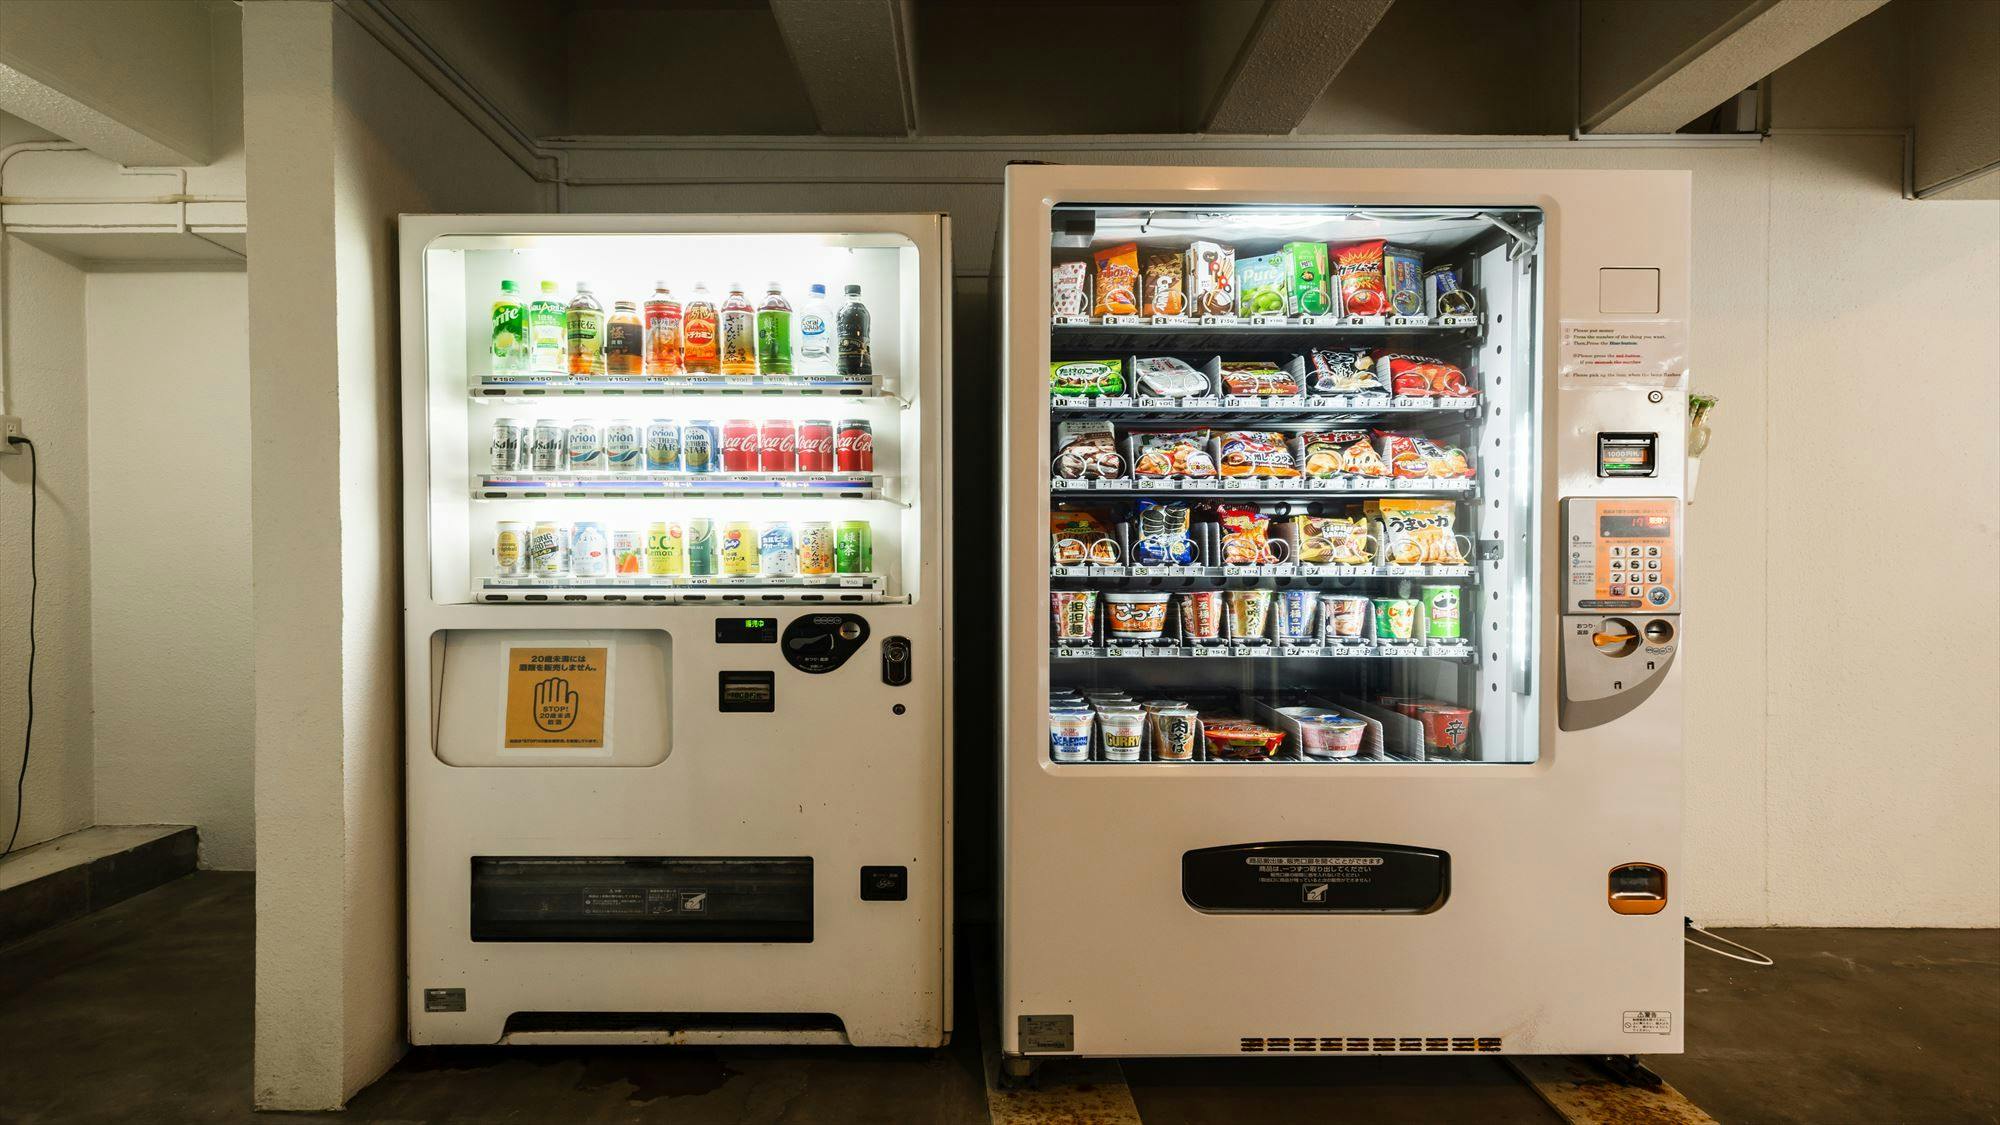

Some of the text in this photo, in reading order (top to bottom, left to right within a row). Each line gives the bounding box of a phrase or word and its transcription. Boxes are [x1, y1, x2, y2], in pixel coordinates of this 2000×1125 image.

[725, 315, 738, 361] さんぴん茶
[1059, 366, 1108, 377] たけのこの里
[811, 529, 820, 567] さんぴん茶
[844, 532, 856, 557] 緑茶
[1631, 547, 1640, 556] 2
[1649, 547, 1658, 556] 3
[1613, 560, 1622, 569] 4
[1613, 573, 1622, 582] 7
[1631, 573, 1640, 582] 8
[1649, 573, 1658, 582] 9
[1630, 586, 1640, 596] 0
[1069, 601, 1085, 635] 担担麺
[1171, 718, 1189, 754] 肉そば
[1445, 719, 1466, 745] 辛
[1051, 732, 1089, 747] SEAFOOD
[1105, 732, 1140, 748] CURRY
